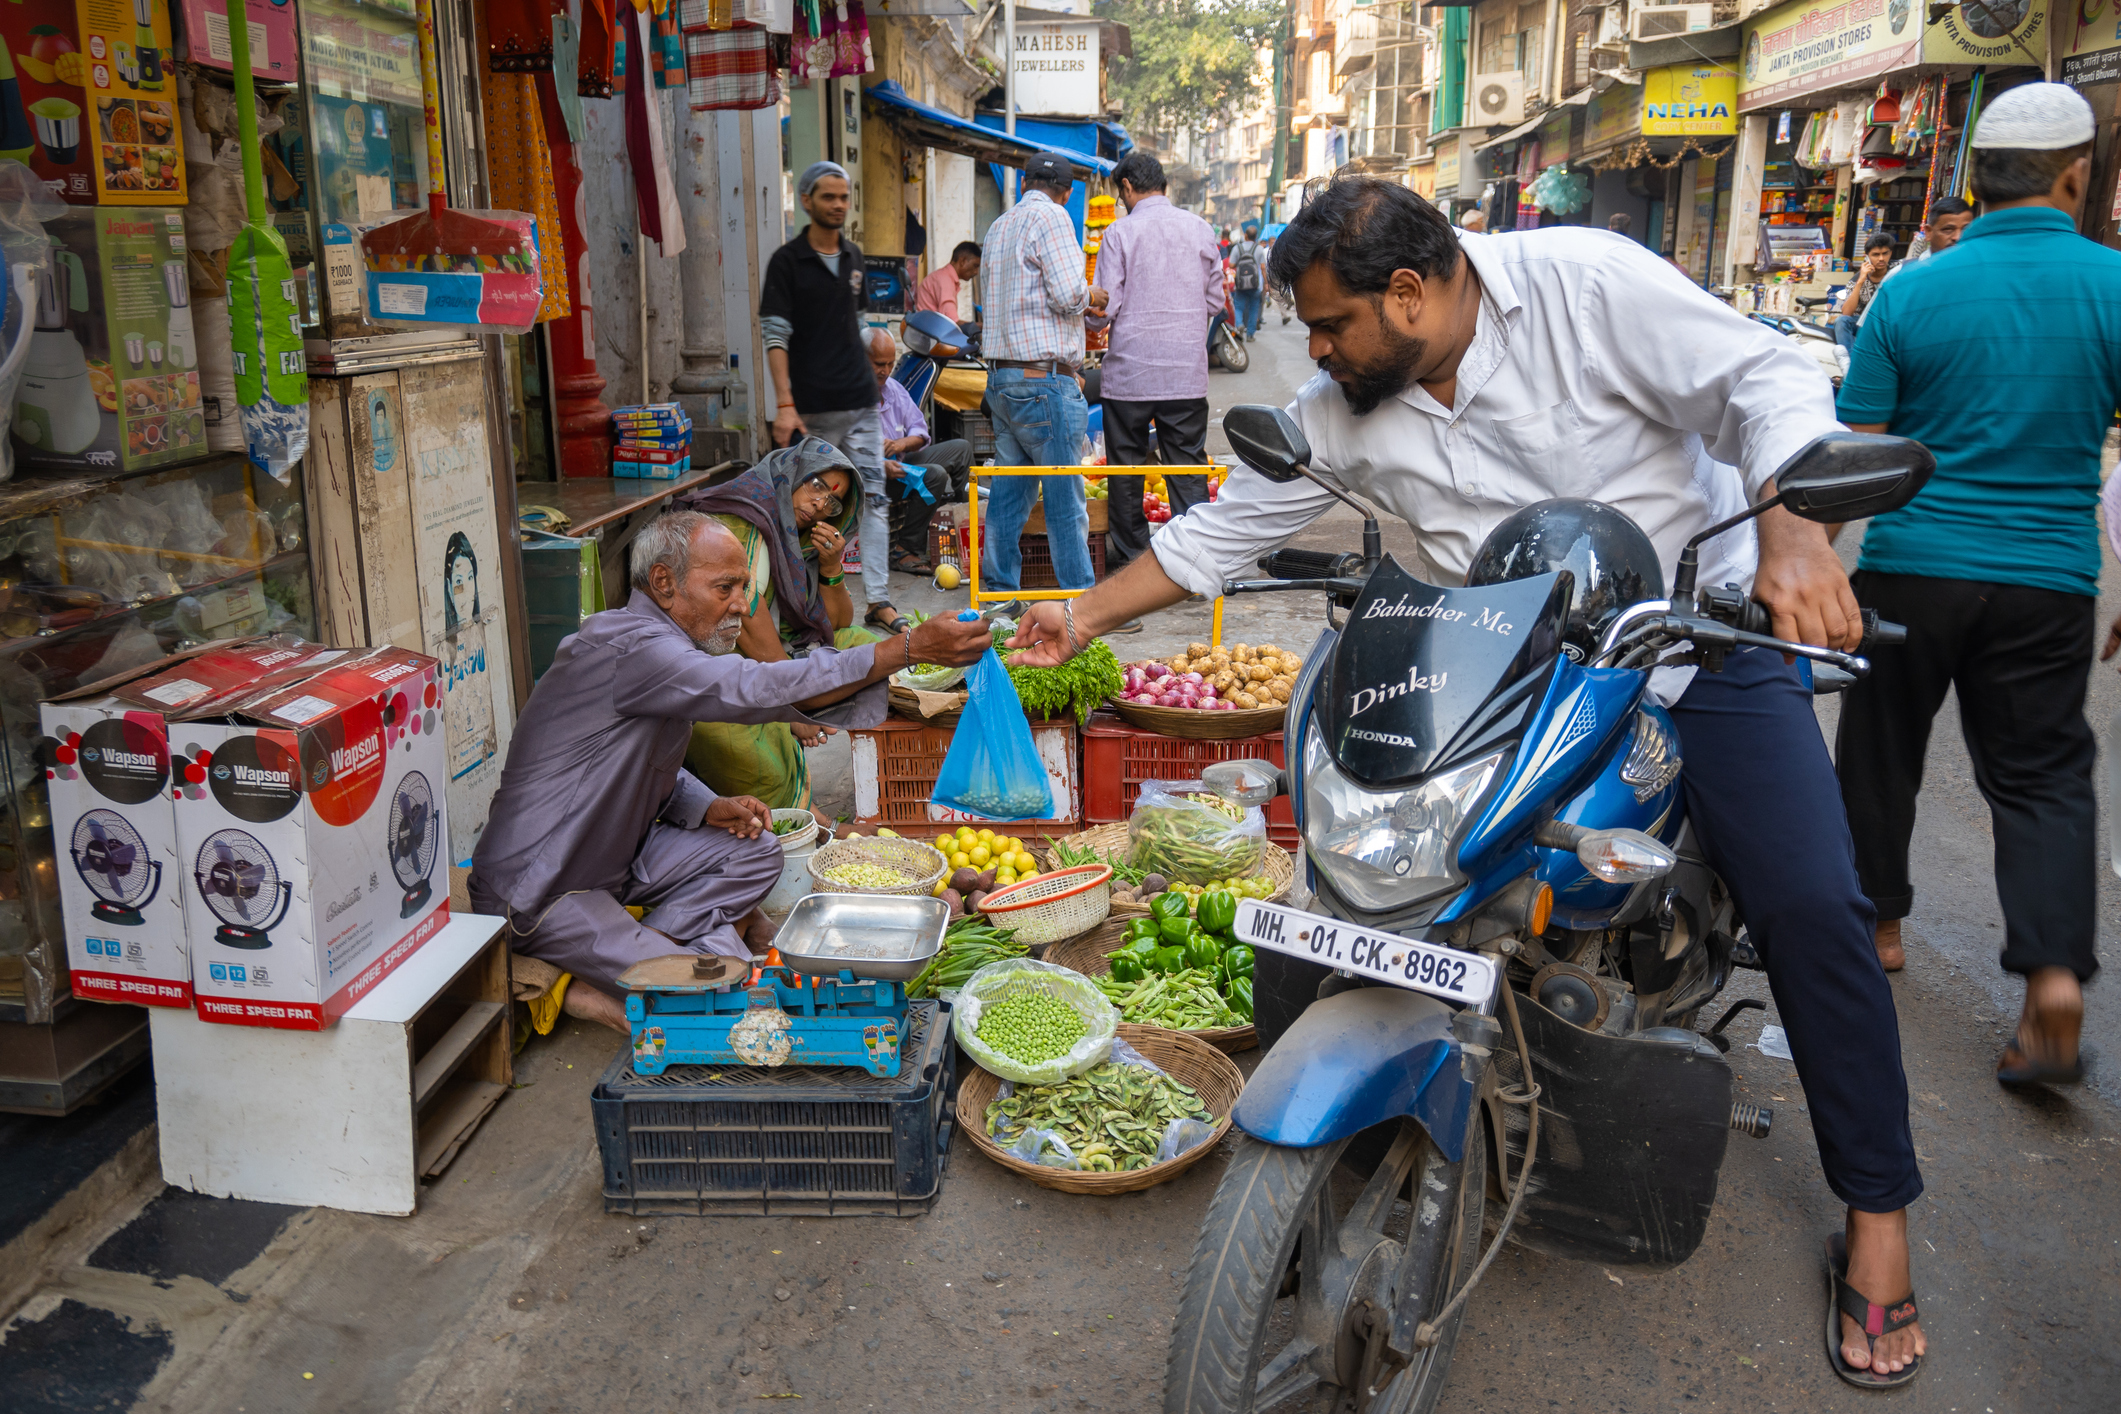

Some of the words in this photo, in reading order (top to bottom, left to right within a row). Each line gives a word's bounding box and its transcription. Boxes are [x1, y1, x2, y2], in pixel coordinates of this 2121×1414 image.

[1015, 35, 1088, 51] MAHESH
[1762, 26, 1794, 57] जनता
[1943, 8, 1959, 42] ANTA
[1956, 37, 2012, 58] PROVISION
[2012, 11, 2045, 48] STORES
[1769, 53, 1791, 73] JANTA
[1793, 38, 1836, 66] PROVISION
[1838, 23, 1872, 49] STORES
[1014, 59, 1085, 72] JEWELLERS
[2077, 70, 2095, 84] Shanti
[1648, 102, 1729, 118] NEHA
[1654, 121, 1682, 131] COPY
[1683, 121, 1722, 131] CENTER
[105, 217, 155, 238] Jaipan
[331, 264, 352, 278] ₹1000
[332, 278, 354, 287] CASHBACK
[1361, 593, 1468, 623] Bahucher
[256, 650, 303, 667] Wapson
[373, 664, 419, 684] Wapson
[1349, 666, 1449, 719] Dinky
[1350, 728, 1417, 748] HONDA
[101, 747, 157, 769] Wapson
[331, 733, 379, 773] Wapson
[233, 765, 290, 786] Wapson
[107, 944, 119, 953] 12
[347, 962, 382, 999] THREE
[383, 934, 415, 969] SPEED
[415, 917, 434, 942] FAN
[1250, 908, 1286, 945] MH.
[1310, 927, 1343, 960] 01.
[1350, 934, 1390, 973] CK.
[1404, 949, 1467, 991] 8962
[231, 969, 243, 978] 12
[78, 976, 118, 990] THREE
[119, 980, 156, 995] SPEED
[158, 985, 182, 998] FAN
[203, 1002, 243, 1015] THREE
[245, 1005, 285, 1018] SPEED
[287, 1008, 313, 1020] FAN
